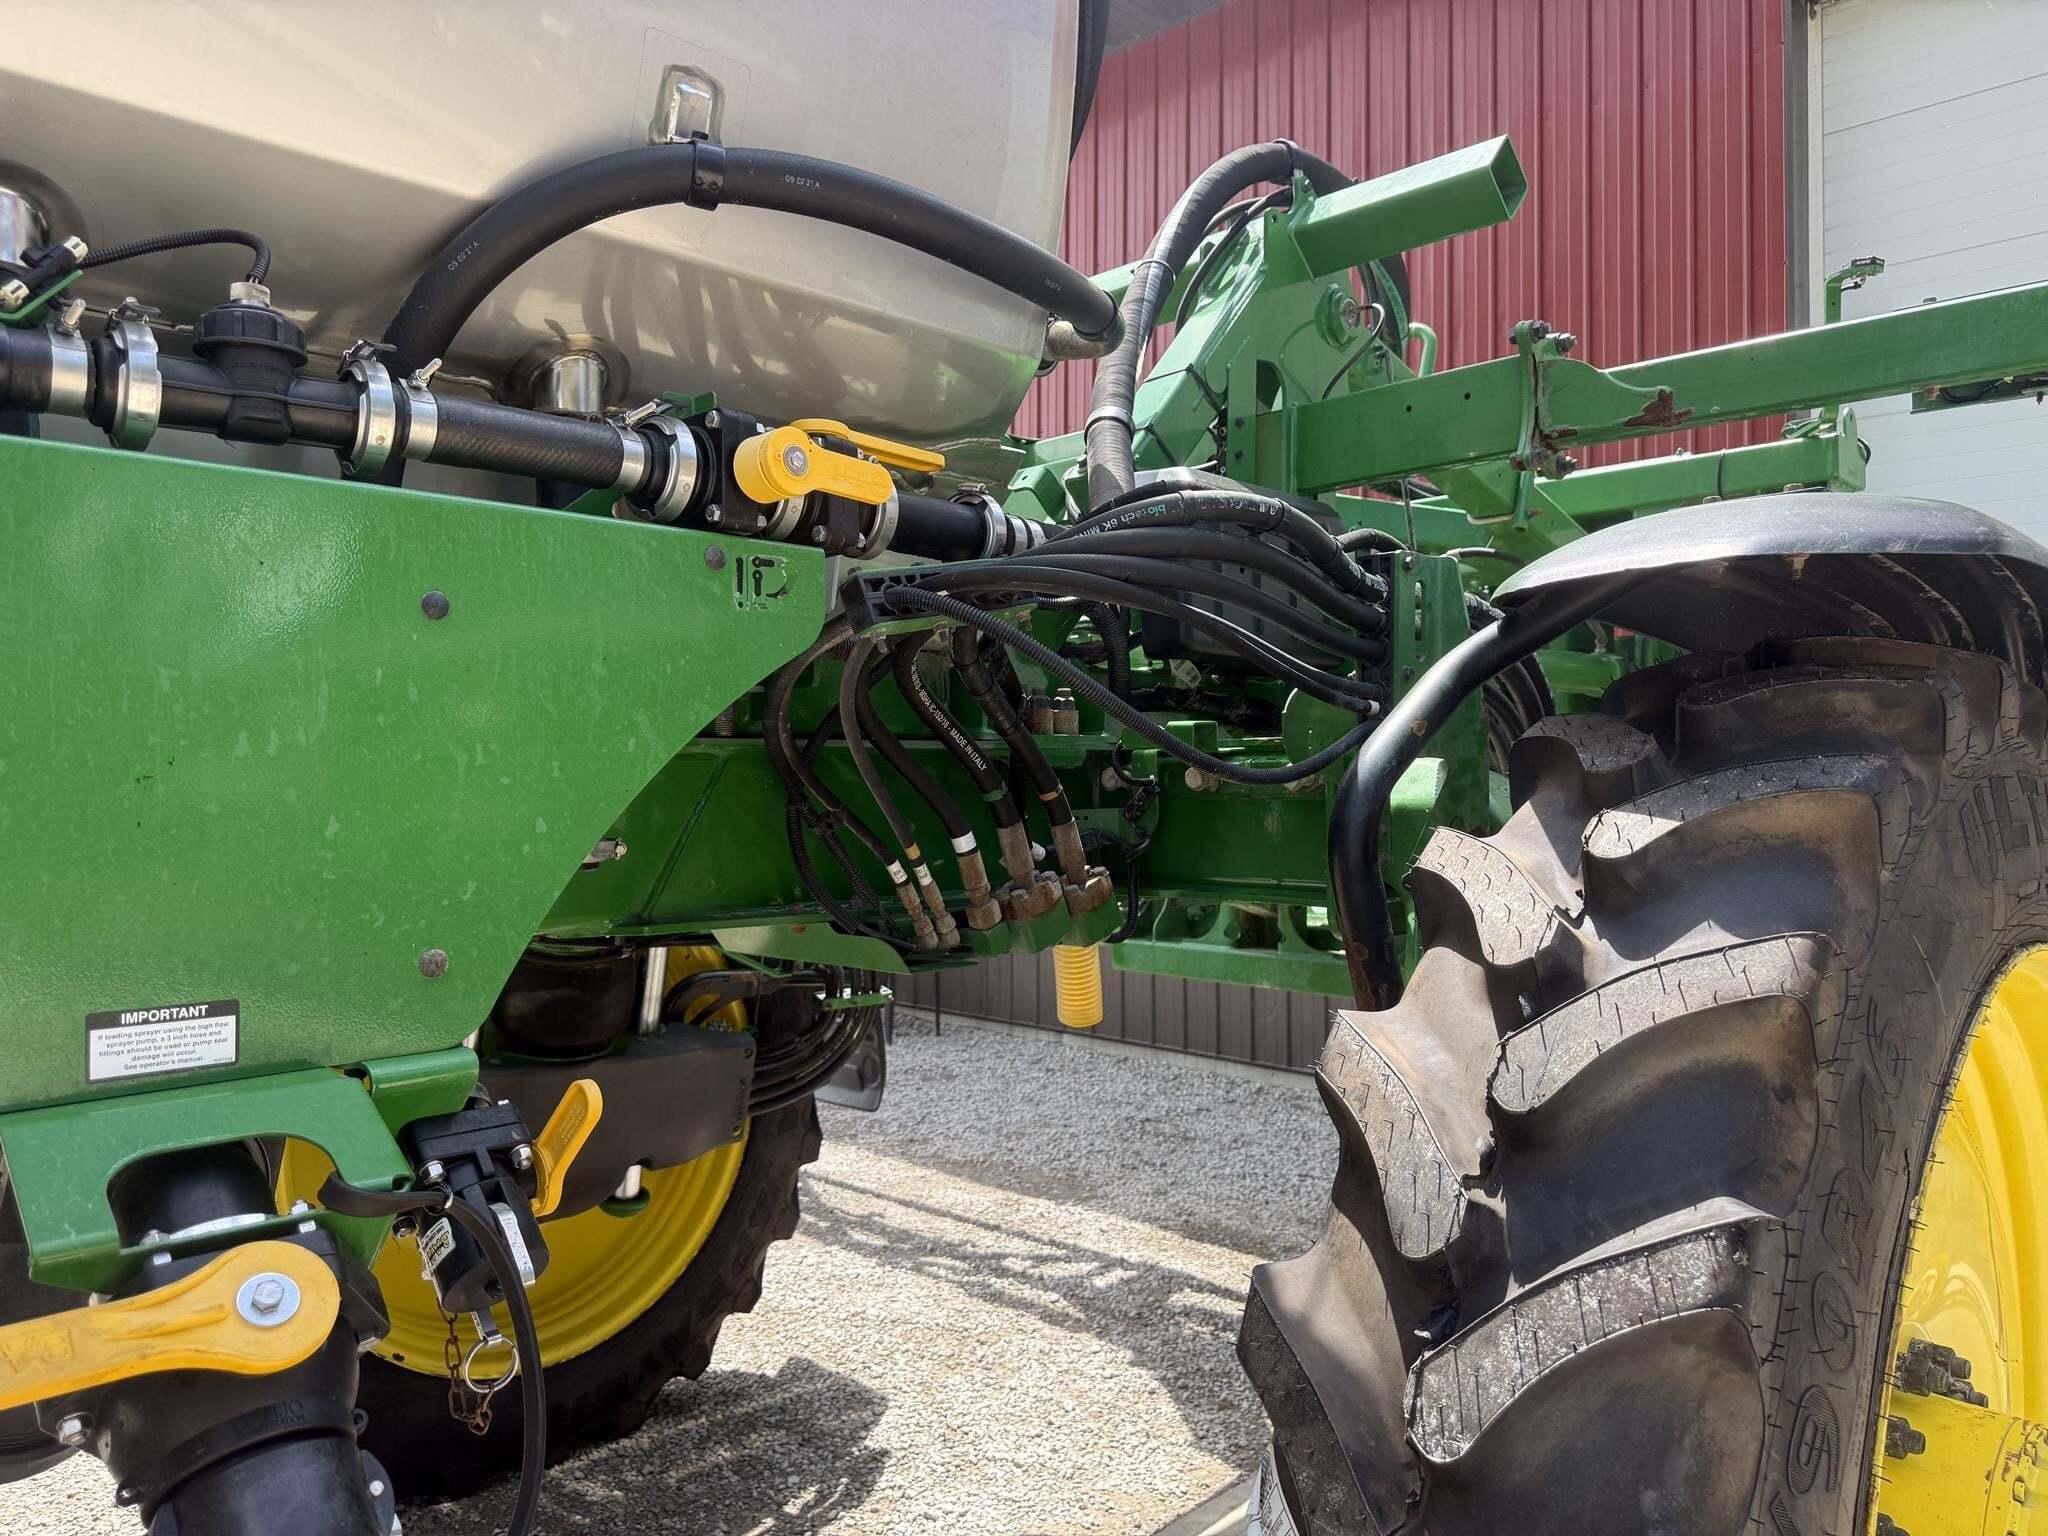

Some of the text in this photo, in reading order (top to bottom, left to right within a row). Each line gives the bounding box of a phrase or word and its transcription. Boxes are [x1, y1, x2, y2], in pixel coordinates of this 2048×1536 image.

[1103, 518, 1118, 532] 6K
[949, 727, 968, 748] MADE
[964, 744, 974, 755] IN
[970, 751, 988, 771] ITALY
[121, 1004, 209, 1025] IMPORTANT
[105, 1032, 132, 1041] loading
[134, 1029, 161, 1037] sprayer
[107, 1040, 134, 1049] sprayer
[173, 1033, 188, 1041] inch
[99, 1048, 125, 1057] fittings
[127, 1045, 151, 1054] should
[193, 1039, 212, 1047] pump
[132, 1053, 160, 1061] damage
[139, 1060, 176, 1069] operator's
